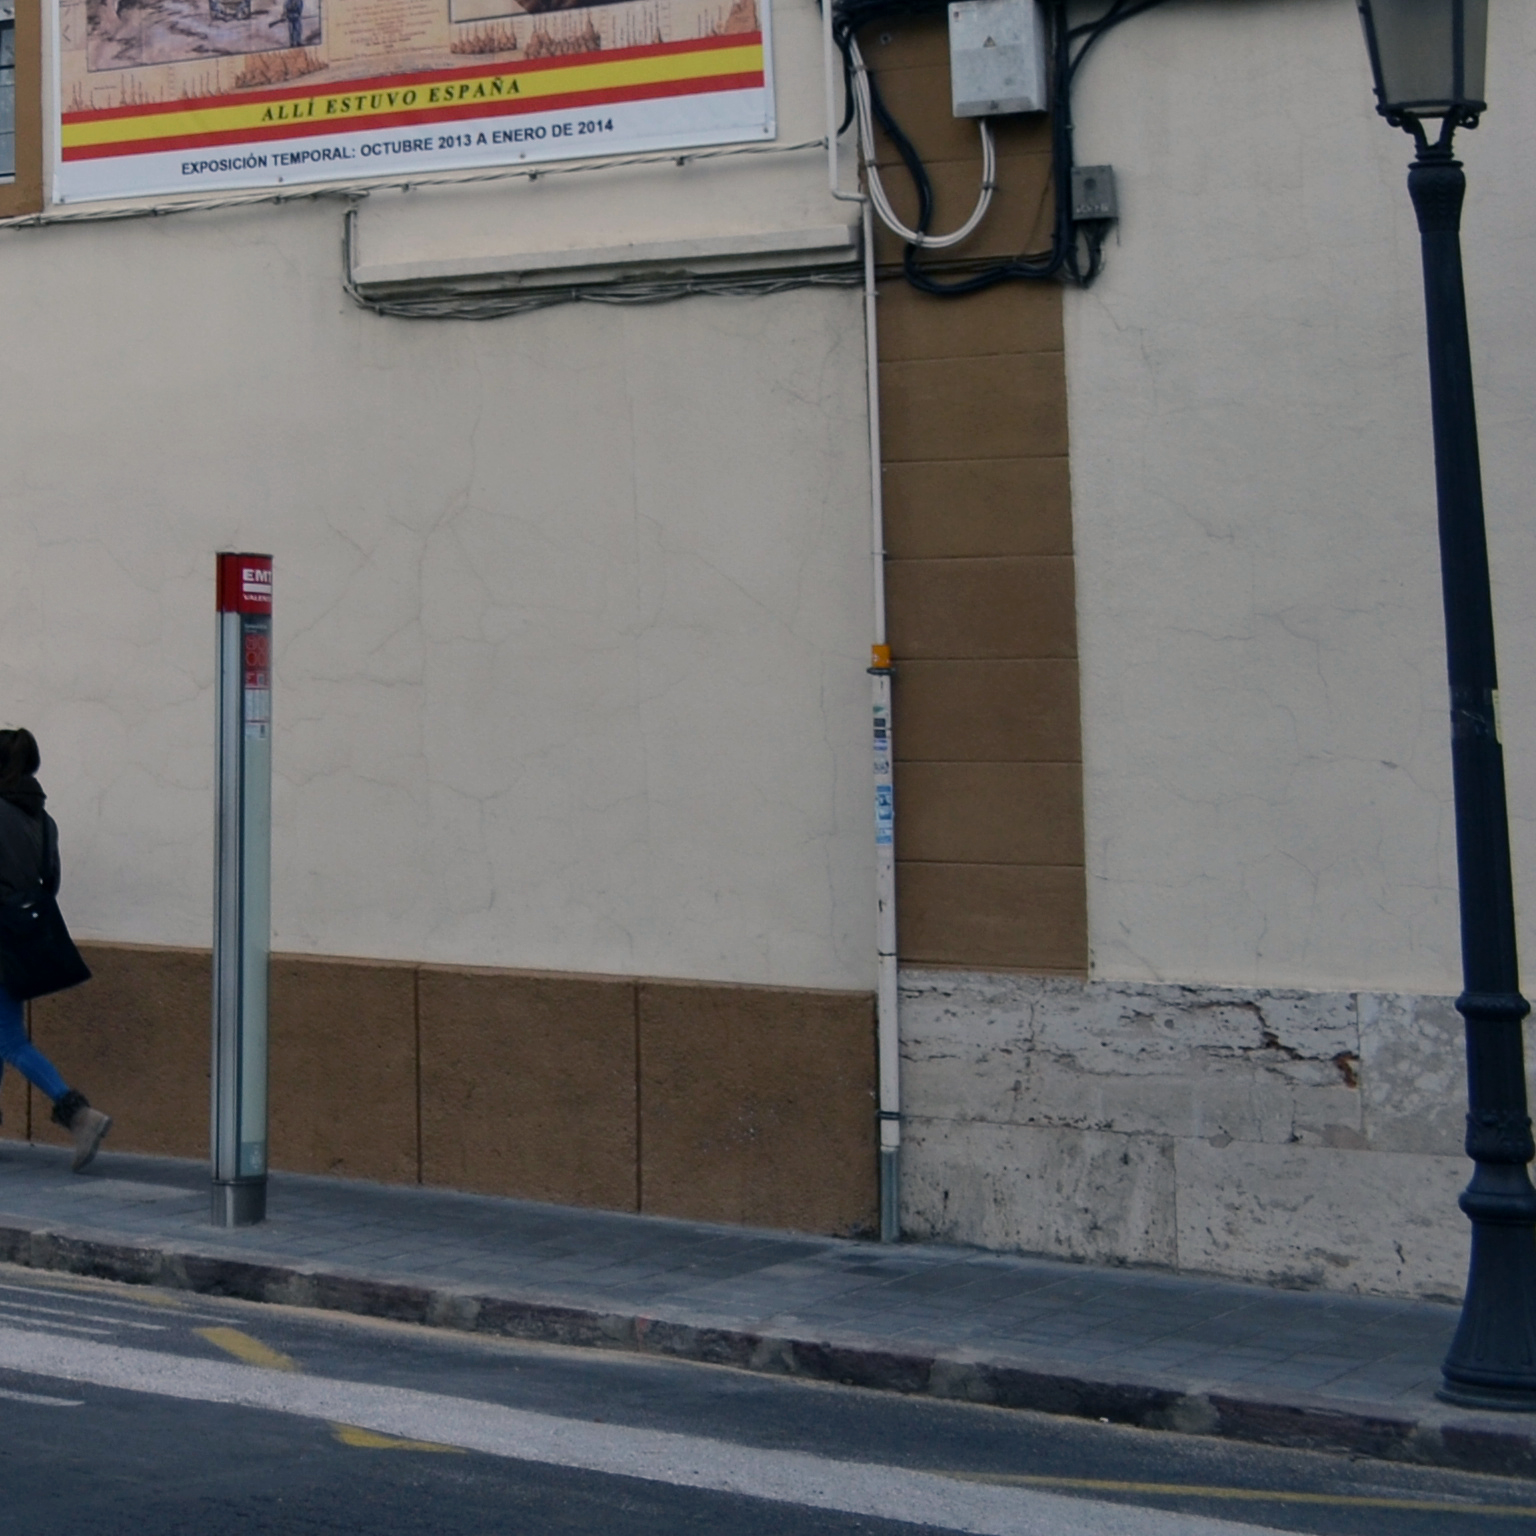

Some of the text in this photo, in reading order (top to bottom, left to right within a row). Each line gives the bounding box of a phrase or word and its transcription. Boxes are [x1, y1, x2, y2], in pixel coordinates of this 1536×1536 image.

[261, 76, 521, 122] ALLÍ ESTUVO ESPAÑA
[181, 118, 614, 175] EXPOSICIÓN TEMPORAL: OCTUBRE 2013 A ENERO DE 2014
